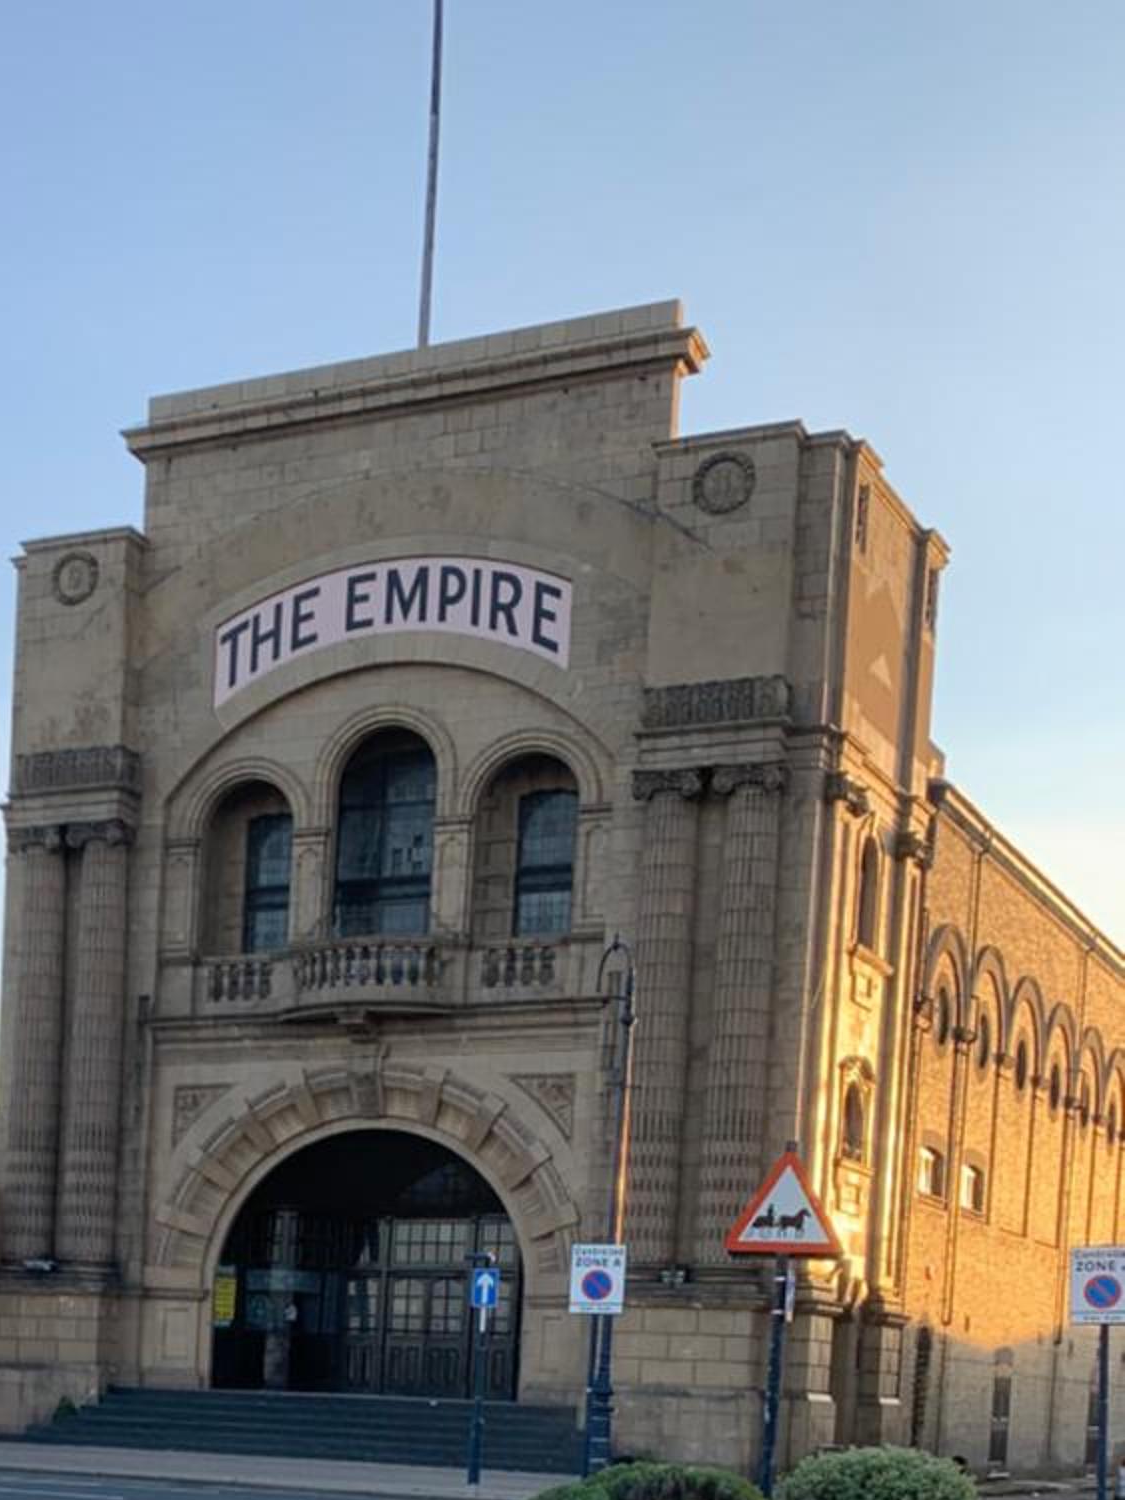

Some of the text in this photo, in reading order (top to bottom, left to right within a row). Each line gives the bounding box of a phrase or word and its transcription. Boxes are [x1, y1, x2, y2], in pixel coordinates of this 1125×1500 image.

[220, 566, 562, 687] THE EMPIRE
[1076, 1260, 1116, 1273] ZONE
